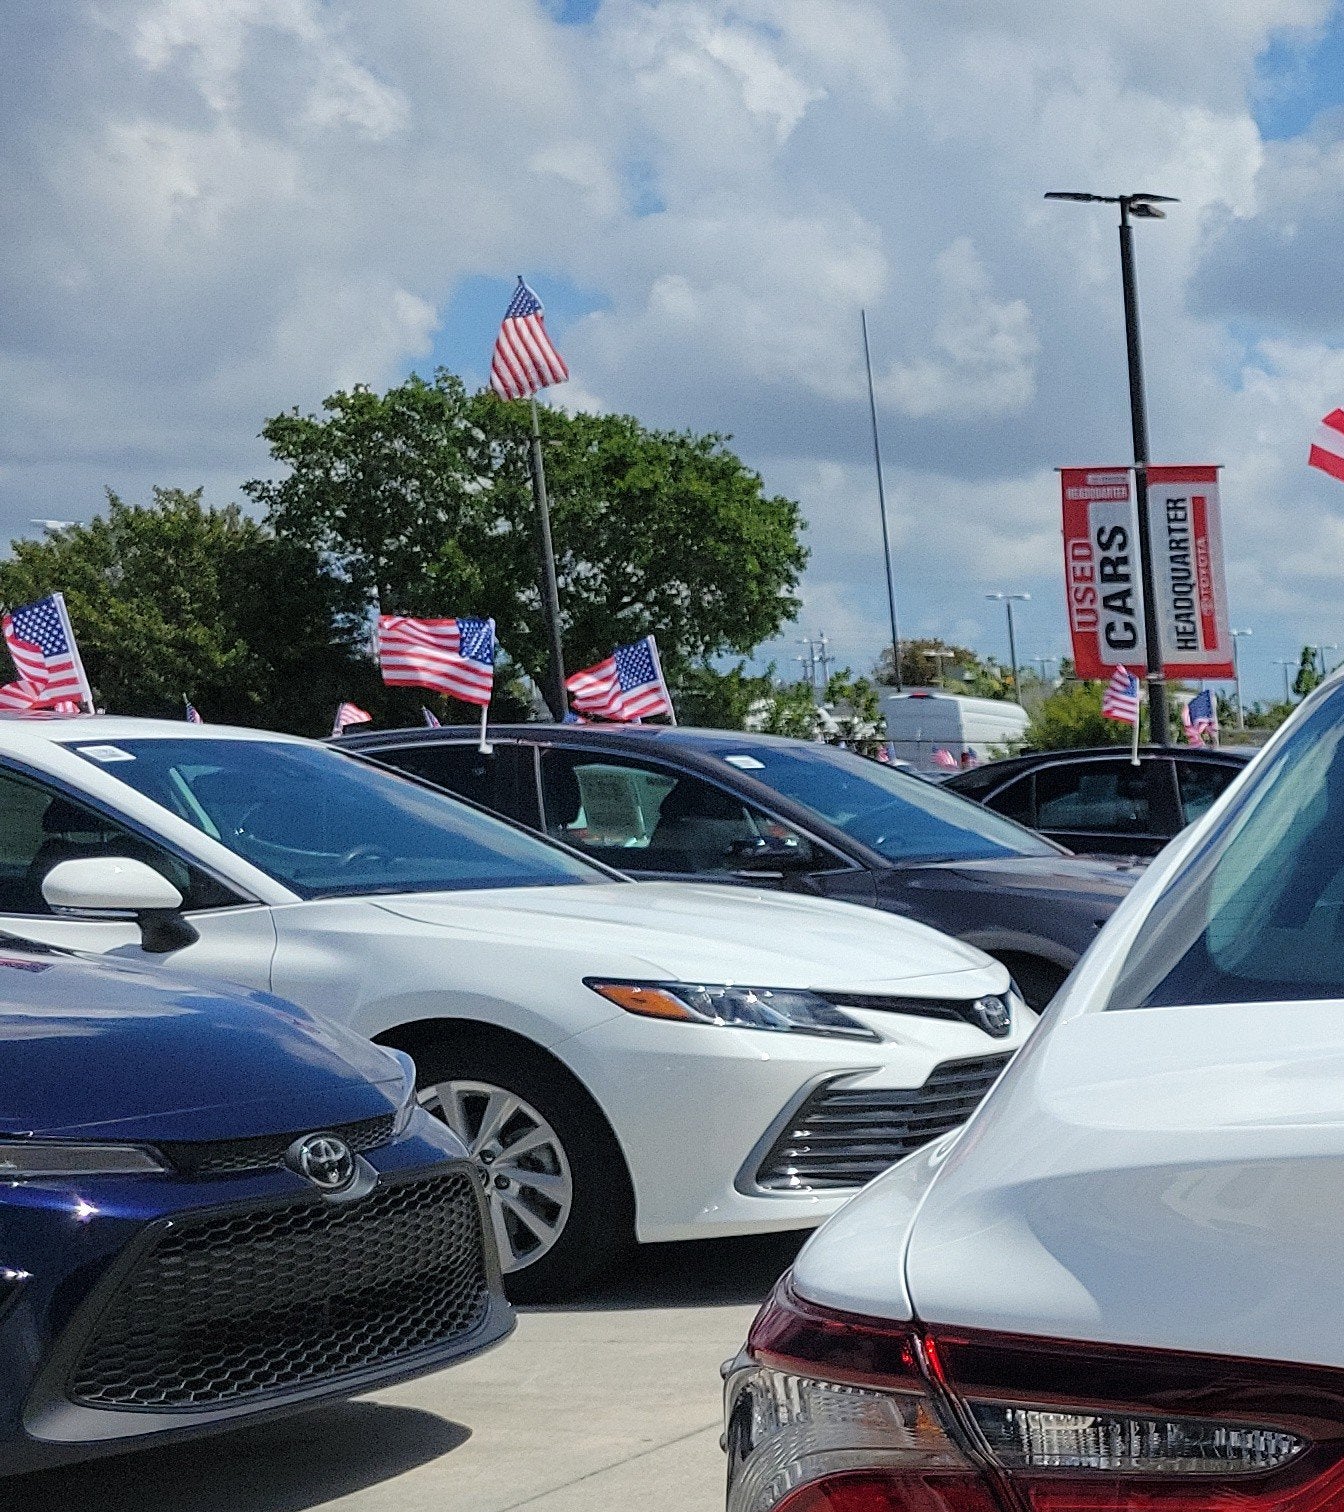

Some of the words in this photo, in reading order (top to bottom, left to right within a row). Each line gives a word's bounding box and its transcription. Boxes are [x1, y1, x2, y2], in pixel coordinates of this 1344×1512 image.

[1068, 539, 1099, 633] USED
[1096, 525, 1138, 650] CARS
[1166, 497, 1198, 652] HEADQUARTER
